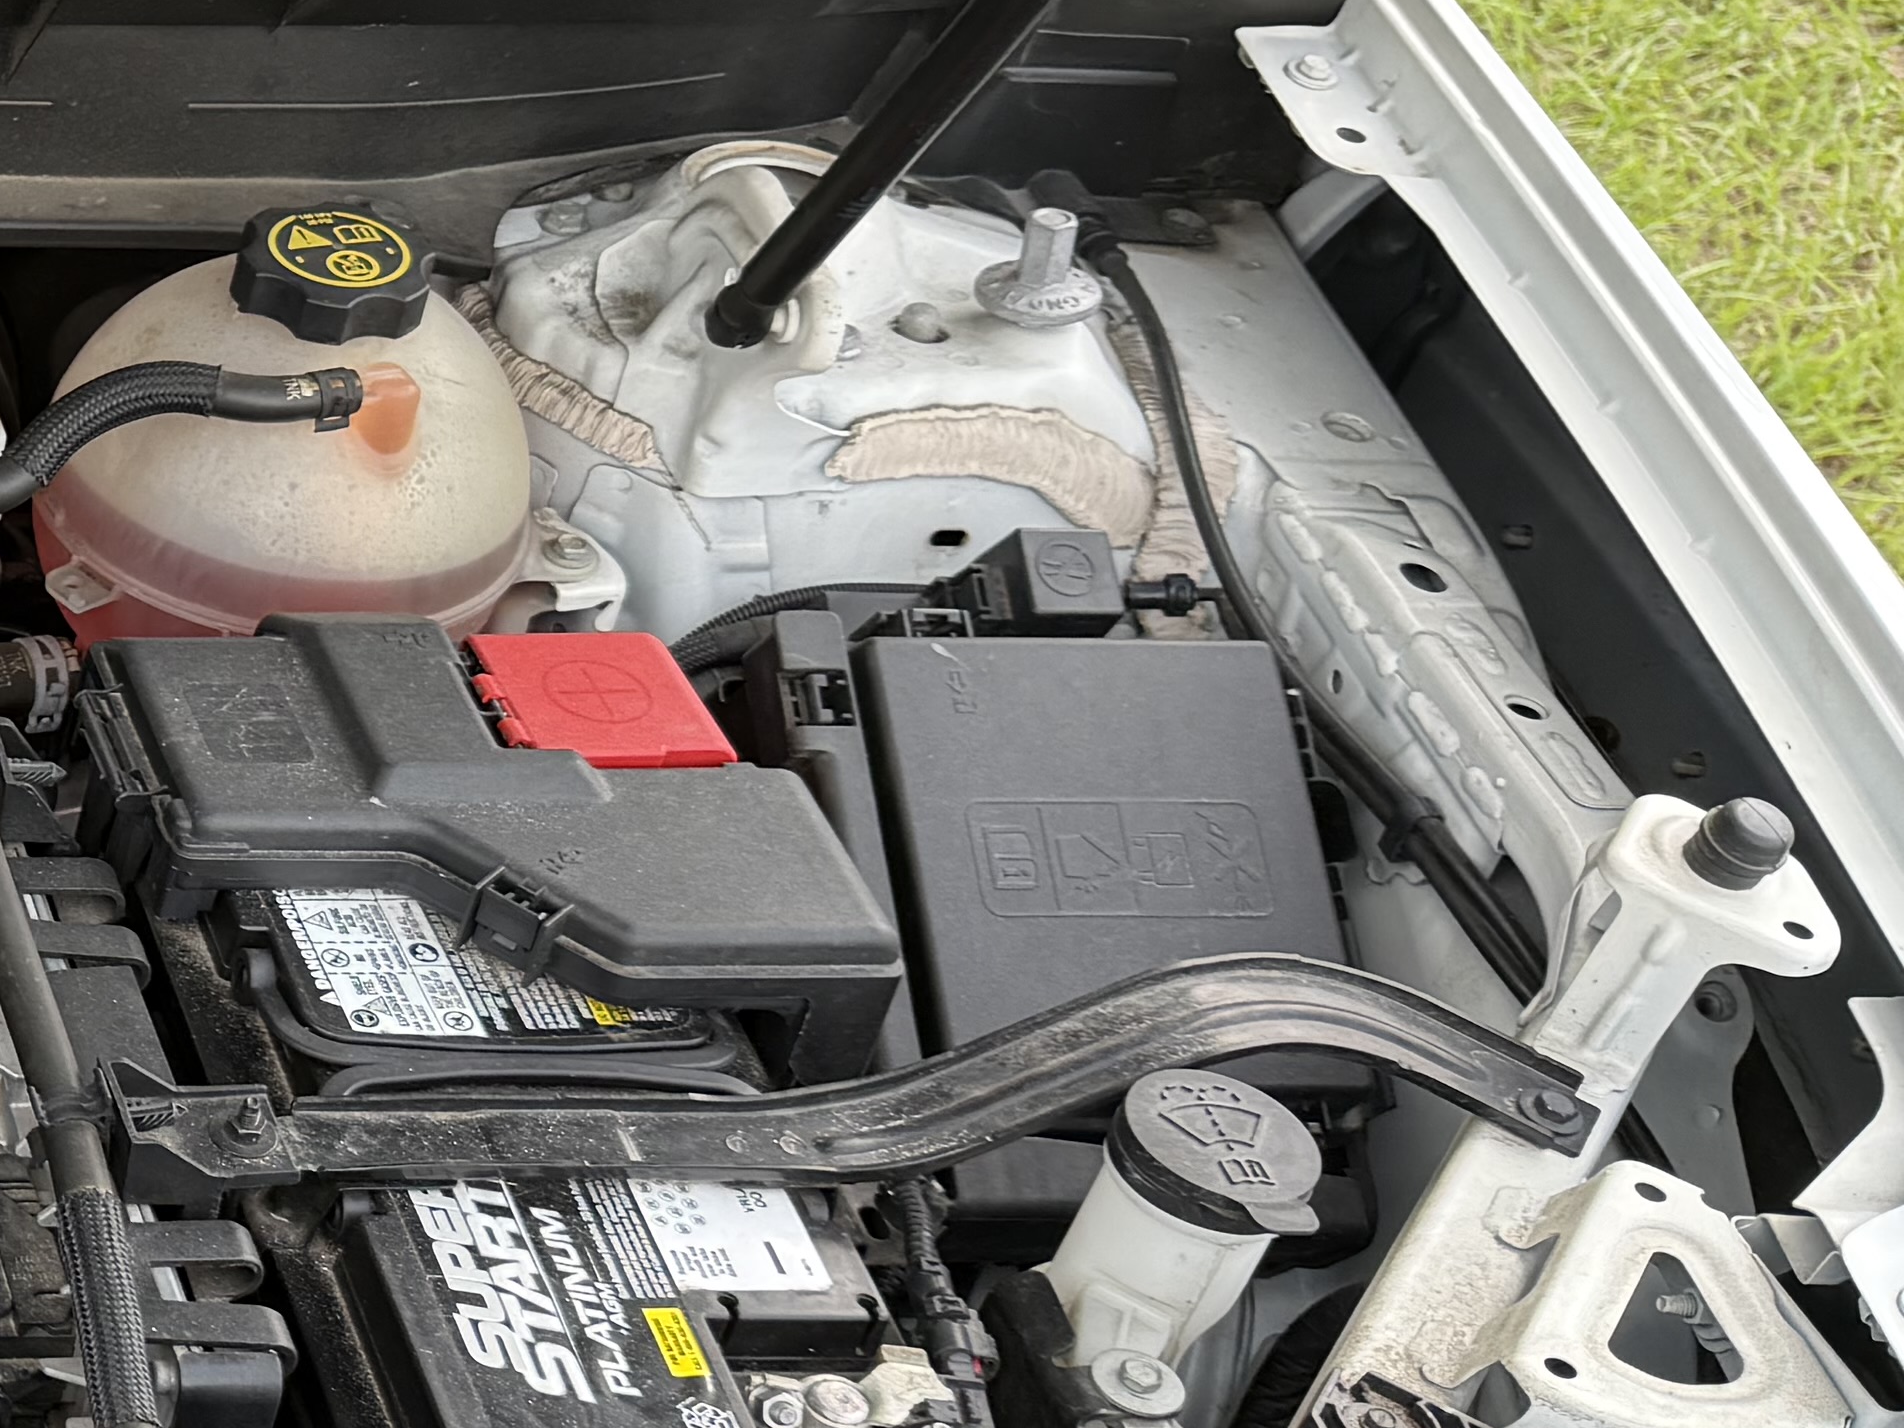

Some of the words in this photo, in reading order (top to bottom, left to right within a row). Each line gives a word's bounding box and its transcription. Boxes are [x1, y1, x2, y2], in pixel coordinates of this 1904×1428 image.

[455, 1180, 597, 1404] START
[529, 1207, 643, 1397] PLATINUM
[594, 1281, 632, 1335] AGM
